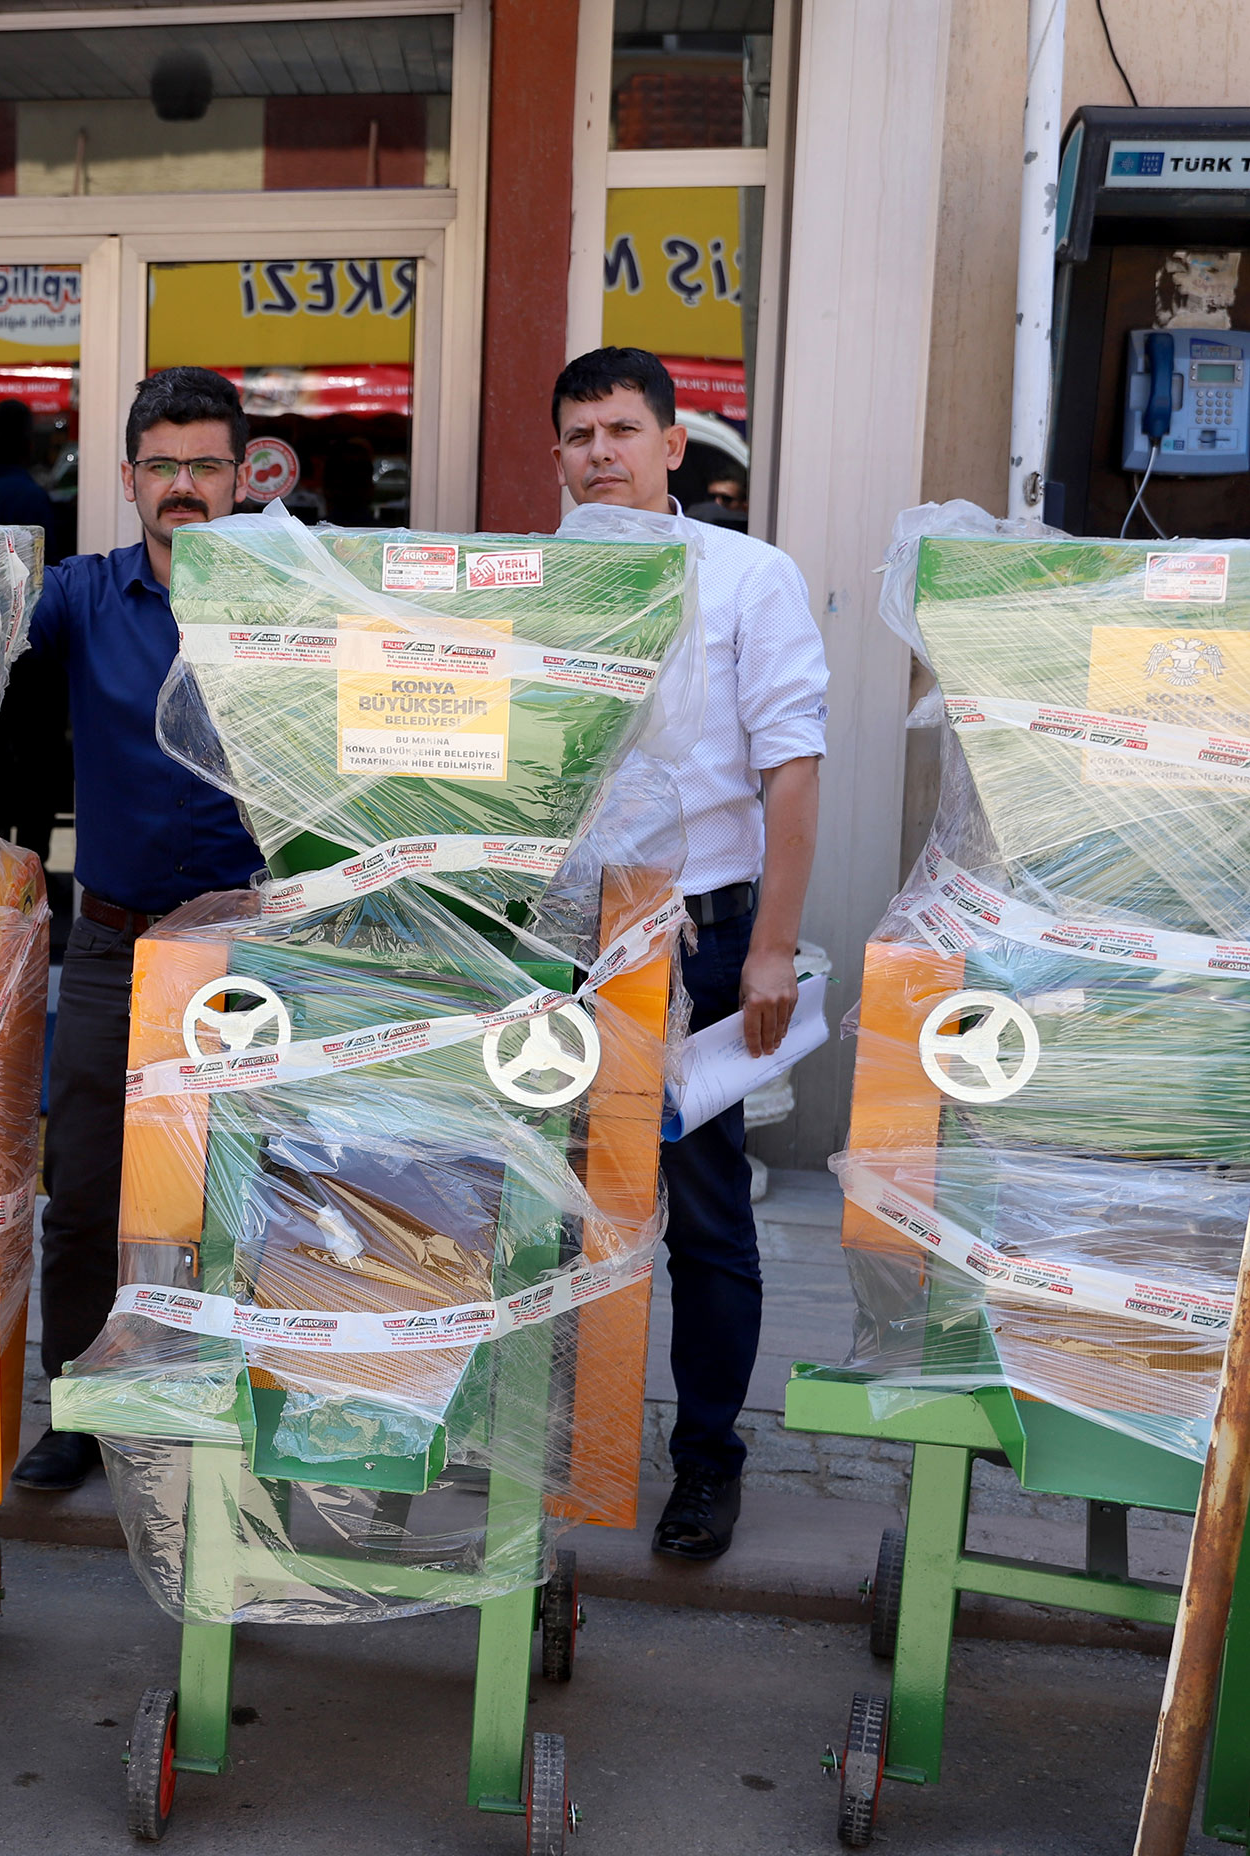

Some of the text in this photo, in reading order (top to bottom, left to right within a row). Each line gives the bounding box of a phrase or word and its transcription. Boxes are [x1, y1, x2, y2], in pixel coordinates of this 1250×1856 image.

[1170, 157, 1233, 172] TÜRK
[497, 557, 528, 569] YERLİ
[497, 570, 538, 581] ÜRETİM
[391, 680, 456, 695] KONYA
[358, 693, 488, 716] BÜYÜKŞEHİR
[385, 715, 461, 727] BELEDİYESİ
[411, 737, 450, 745] MAKİNA
[345, 745, 500, 759] KONYA BÜYÜKŞEHİR BELEDİYESİ
[350, 757, 495, 771] TARAFINDAN HİBE EDİLMİŞTİR.
